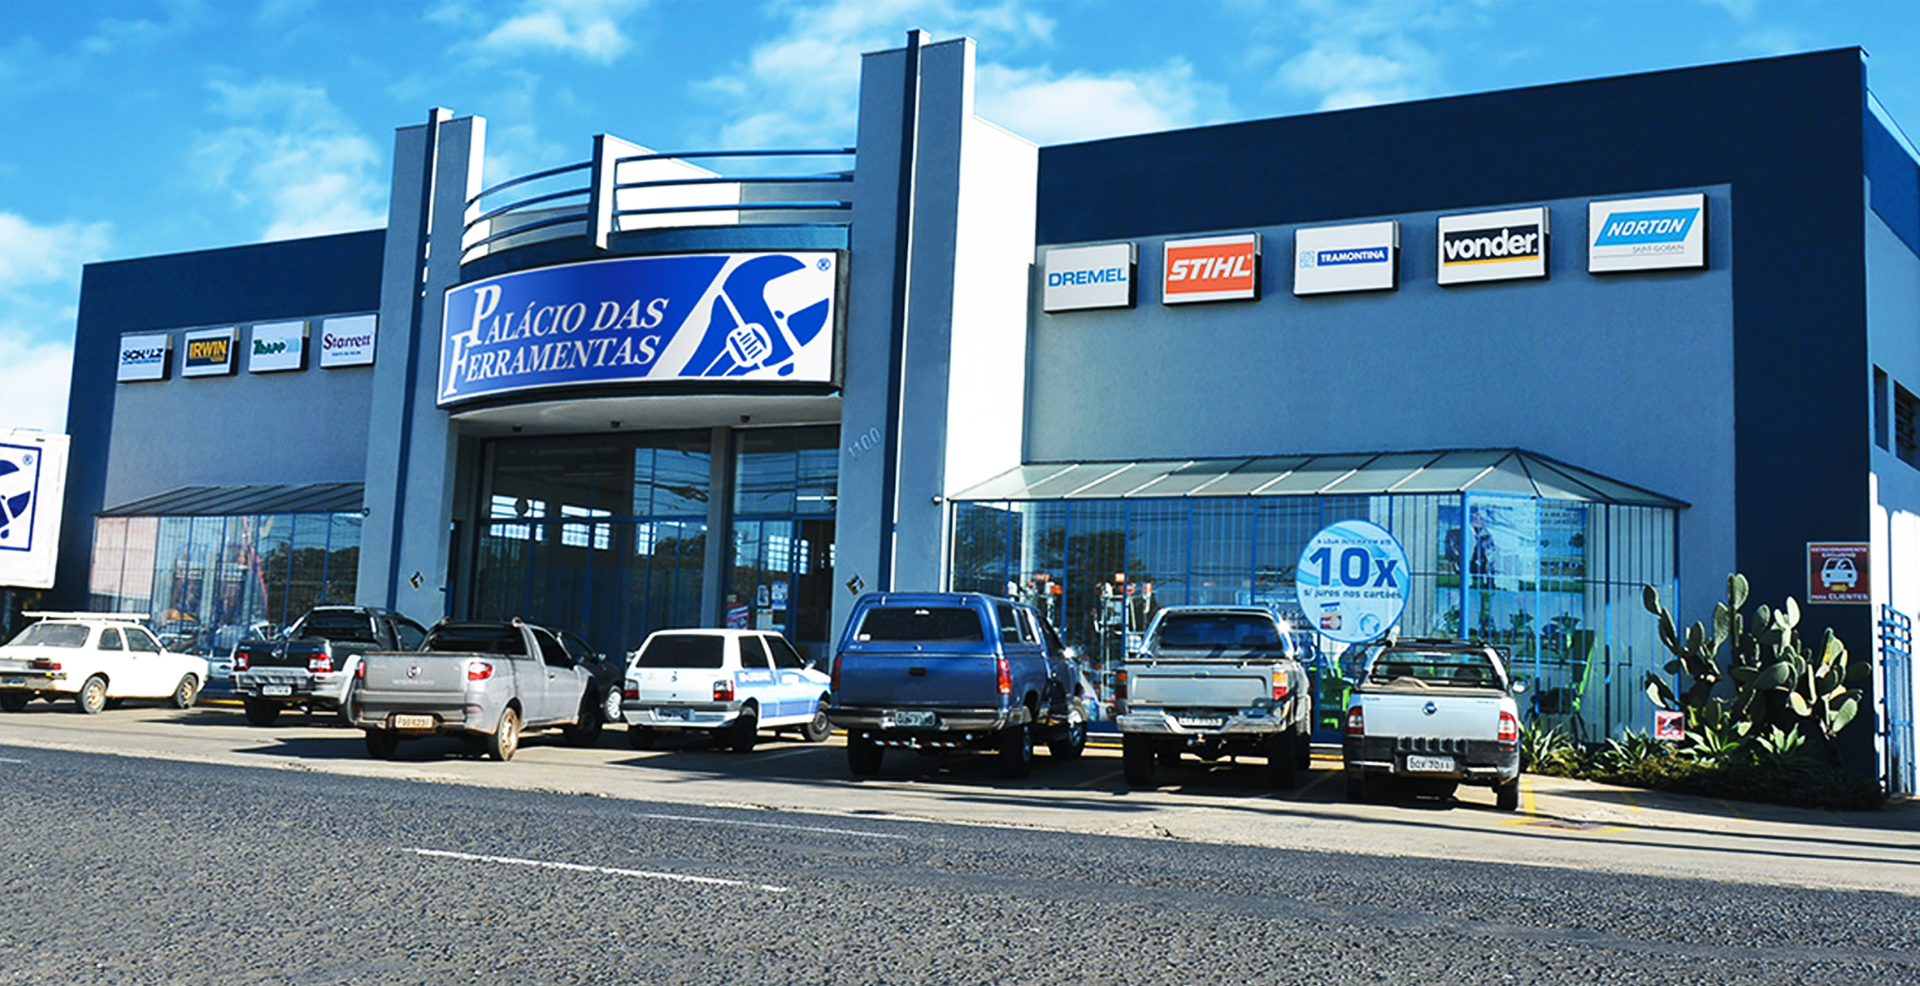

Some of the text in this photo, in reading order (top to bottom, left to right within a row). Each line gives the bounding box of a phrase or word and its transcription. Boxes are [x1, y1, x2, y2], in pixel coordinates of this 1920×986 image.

[1607, 218, 1686, 237] NORTON
[1320, 251, 1385, 263] TRAMONTINA
[1048, 268, 1127, 287] DREMEL
[1168, 255, 1252, 281] STIHL
[466, 284, 670, 347] PALÁCIO DAS
[189, 340, 227, 359] IRWIN
[443, 330, 661, 397] FERRAMENTAS
[1309, 547, 1398, 588] 10x
[1314, 589, 1340, 598] juros
[1343, 590, 1361, 598] nos
[1363, 590, 1403, 599] cartões
